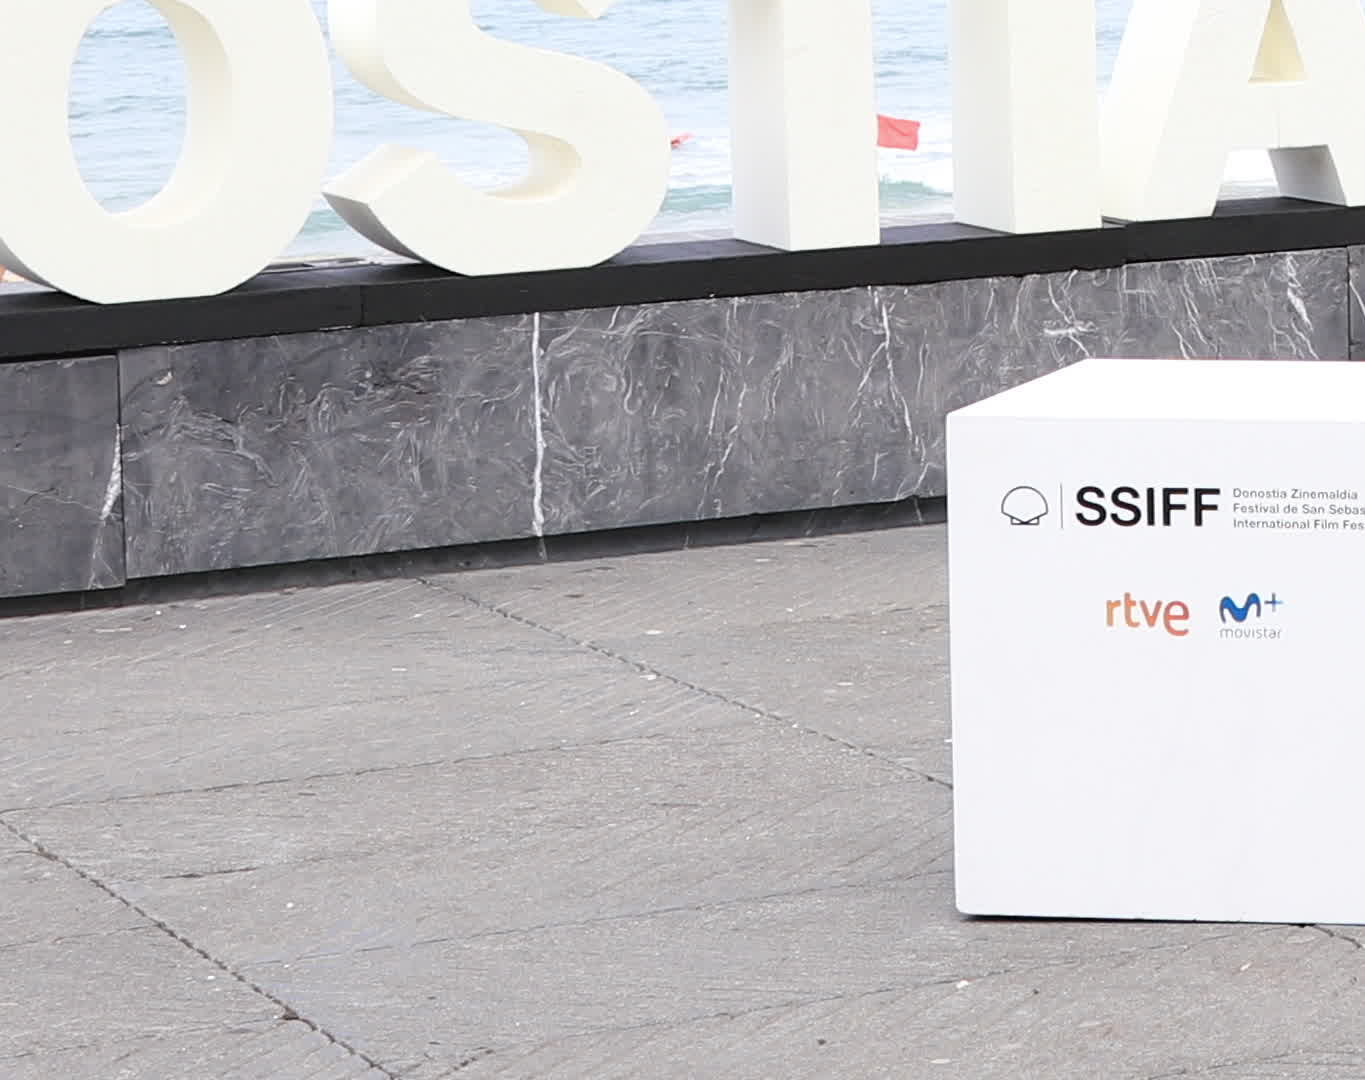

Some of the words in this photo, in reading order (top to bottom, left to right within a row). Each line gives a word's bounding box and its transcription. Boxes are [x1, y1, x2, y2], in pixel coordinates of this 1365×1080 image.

[1233, 488, 1287, 499] Donostia
[1291, 489, 1358, 501] Zinemaldia
[1075, 485, 1221, 527] SSIFF
[1233, 503, 1280, 514] Festival
[1283, 504, 1298, 514] de
[1302, 504, 1325, 515] San
[1233, 519, 1310, 530] International
[1314, 520, 1339, 530] Film
[1106, 592, 1190, 637] rtve
[1219, 627, 1283, 639] movistar
